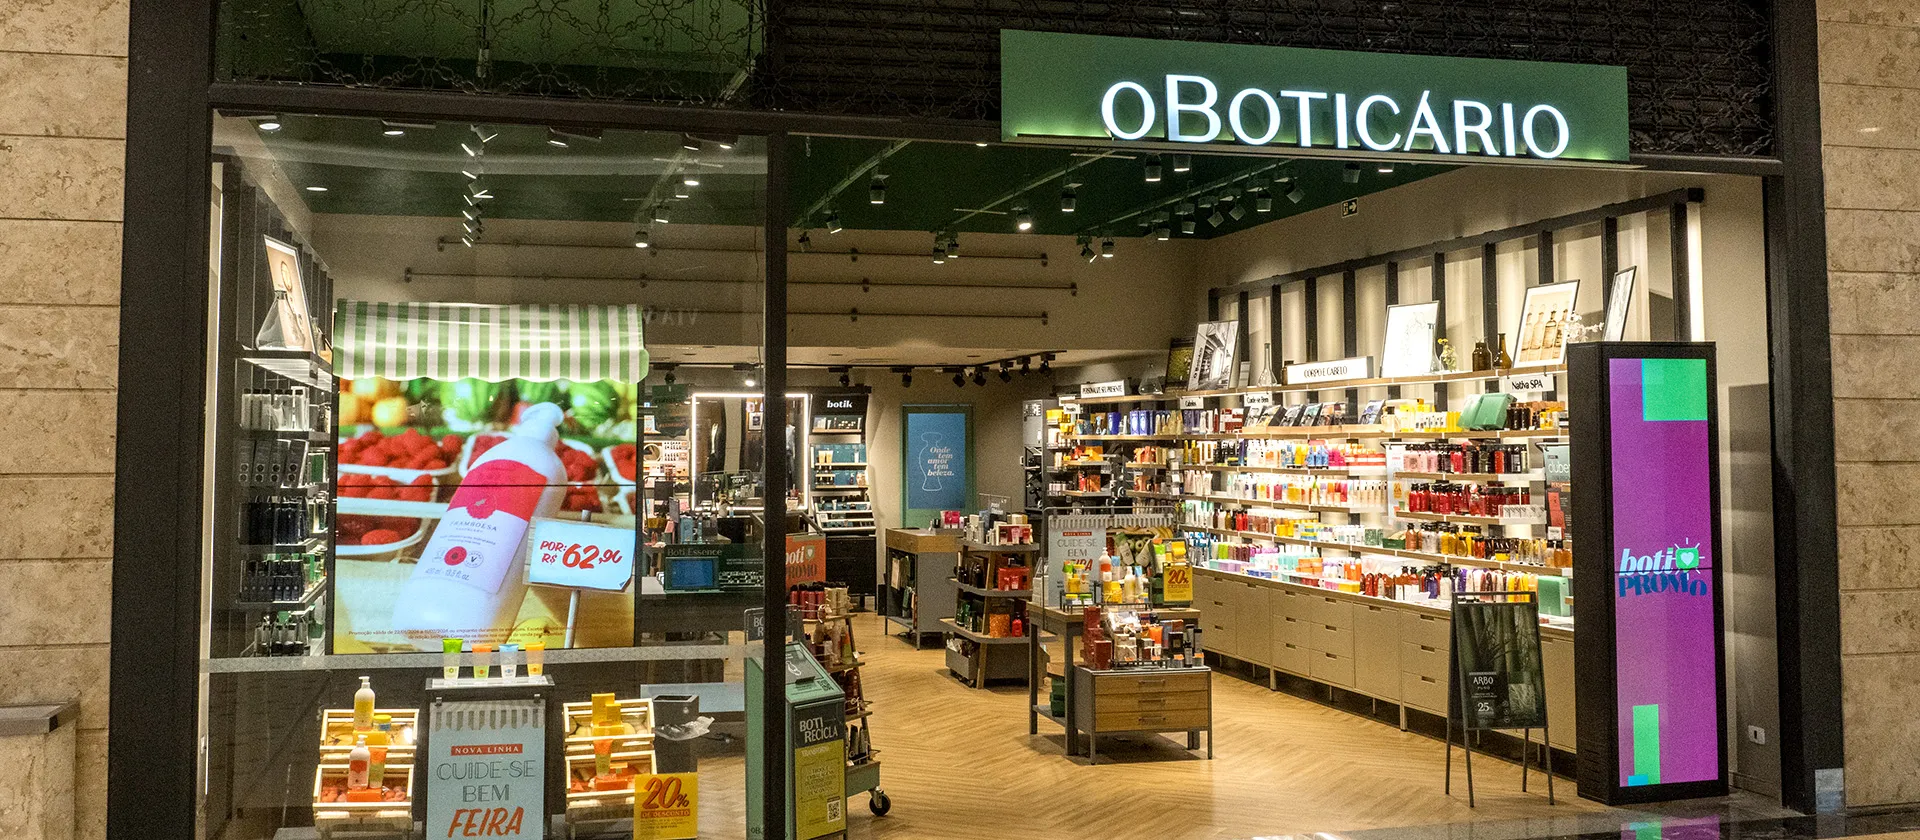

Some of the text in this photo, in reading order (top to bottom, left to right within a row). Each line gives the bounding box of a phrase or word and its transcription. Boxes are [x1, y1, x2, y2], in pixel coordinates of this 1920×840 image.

[1303, 368, 1323, 378] CORPO
[1327, 365, 1348, 376] CABELO
[1511, 378, 1544, 390] Nativa SPA
[826, 400, 853, 409] botik
[540, 540, 567, 552] POR:
[667, 547, 723, 556] Boti Essence
[1067, 548, 1087, 556] BEM
[542, 552, 558, 565] R$
[1619, 547, 1674, 576] boti
[1168, 569, 1190, 584] 20%
[1618, 572, 1707, 597] PROMO
[1473, 676, 1494, 685] ARBO
[800, 717, 824, 732] BOTI
[804, 725, 839, 744] RECICLA
[436, 760, 536, 780] CUIDE-SE
[462, 784, 510, 802] BEM
[642, 776, 690, 809] 20%
[447, 806, 524, 838] FEIRA
